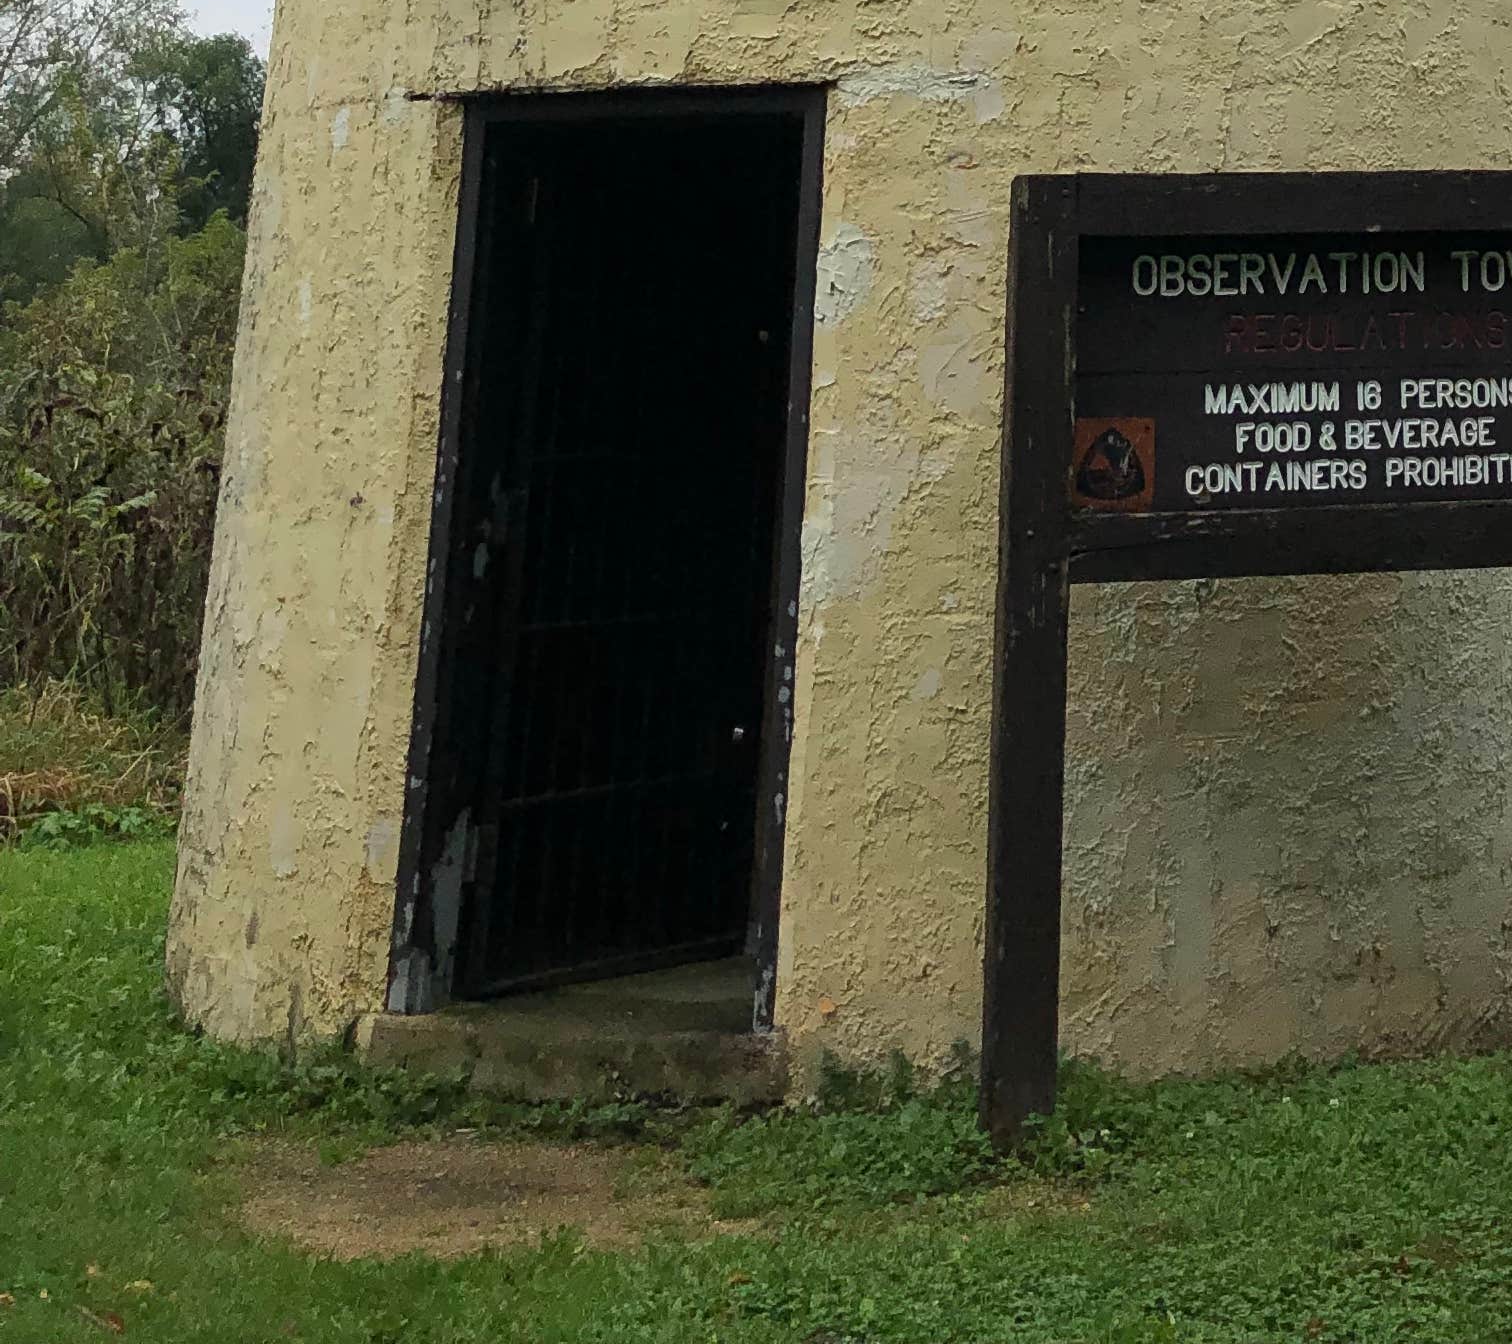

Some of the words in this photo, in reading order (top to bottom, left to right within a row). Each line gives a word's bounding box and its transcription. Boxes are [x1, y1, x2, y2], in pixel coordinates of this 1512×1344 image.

[1132, 252, 1425, 297] OBSERVATION
[1223, 312, 1512, 353] REGULATONS
[1204, 381, 1340, 414] MAXIMUM
[1357, 380, 1382, 411] 16
[1235, 421, 1312, 454] FOOD
[1318, 420, 1337, 451] &
[1344, 416, 1496, 450] BEVERAGE
[1185, 458, 1367, 496] CONTAINERS
